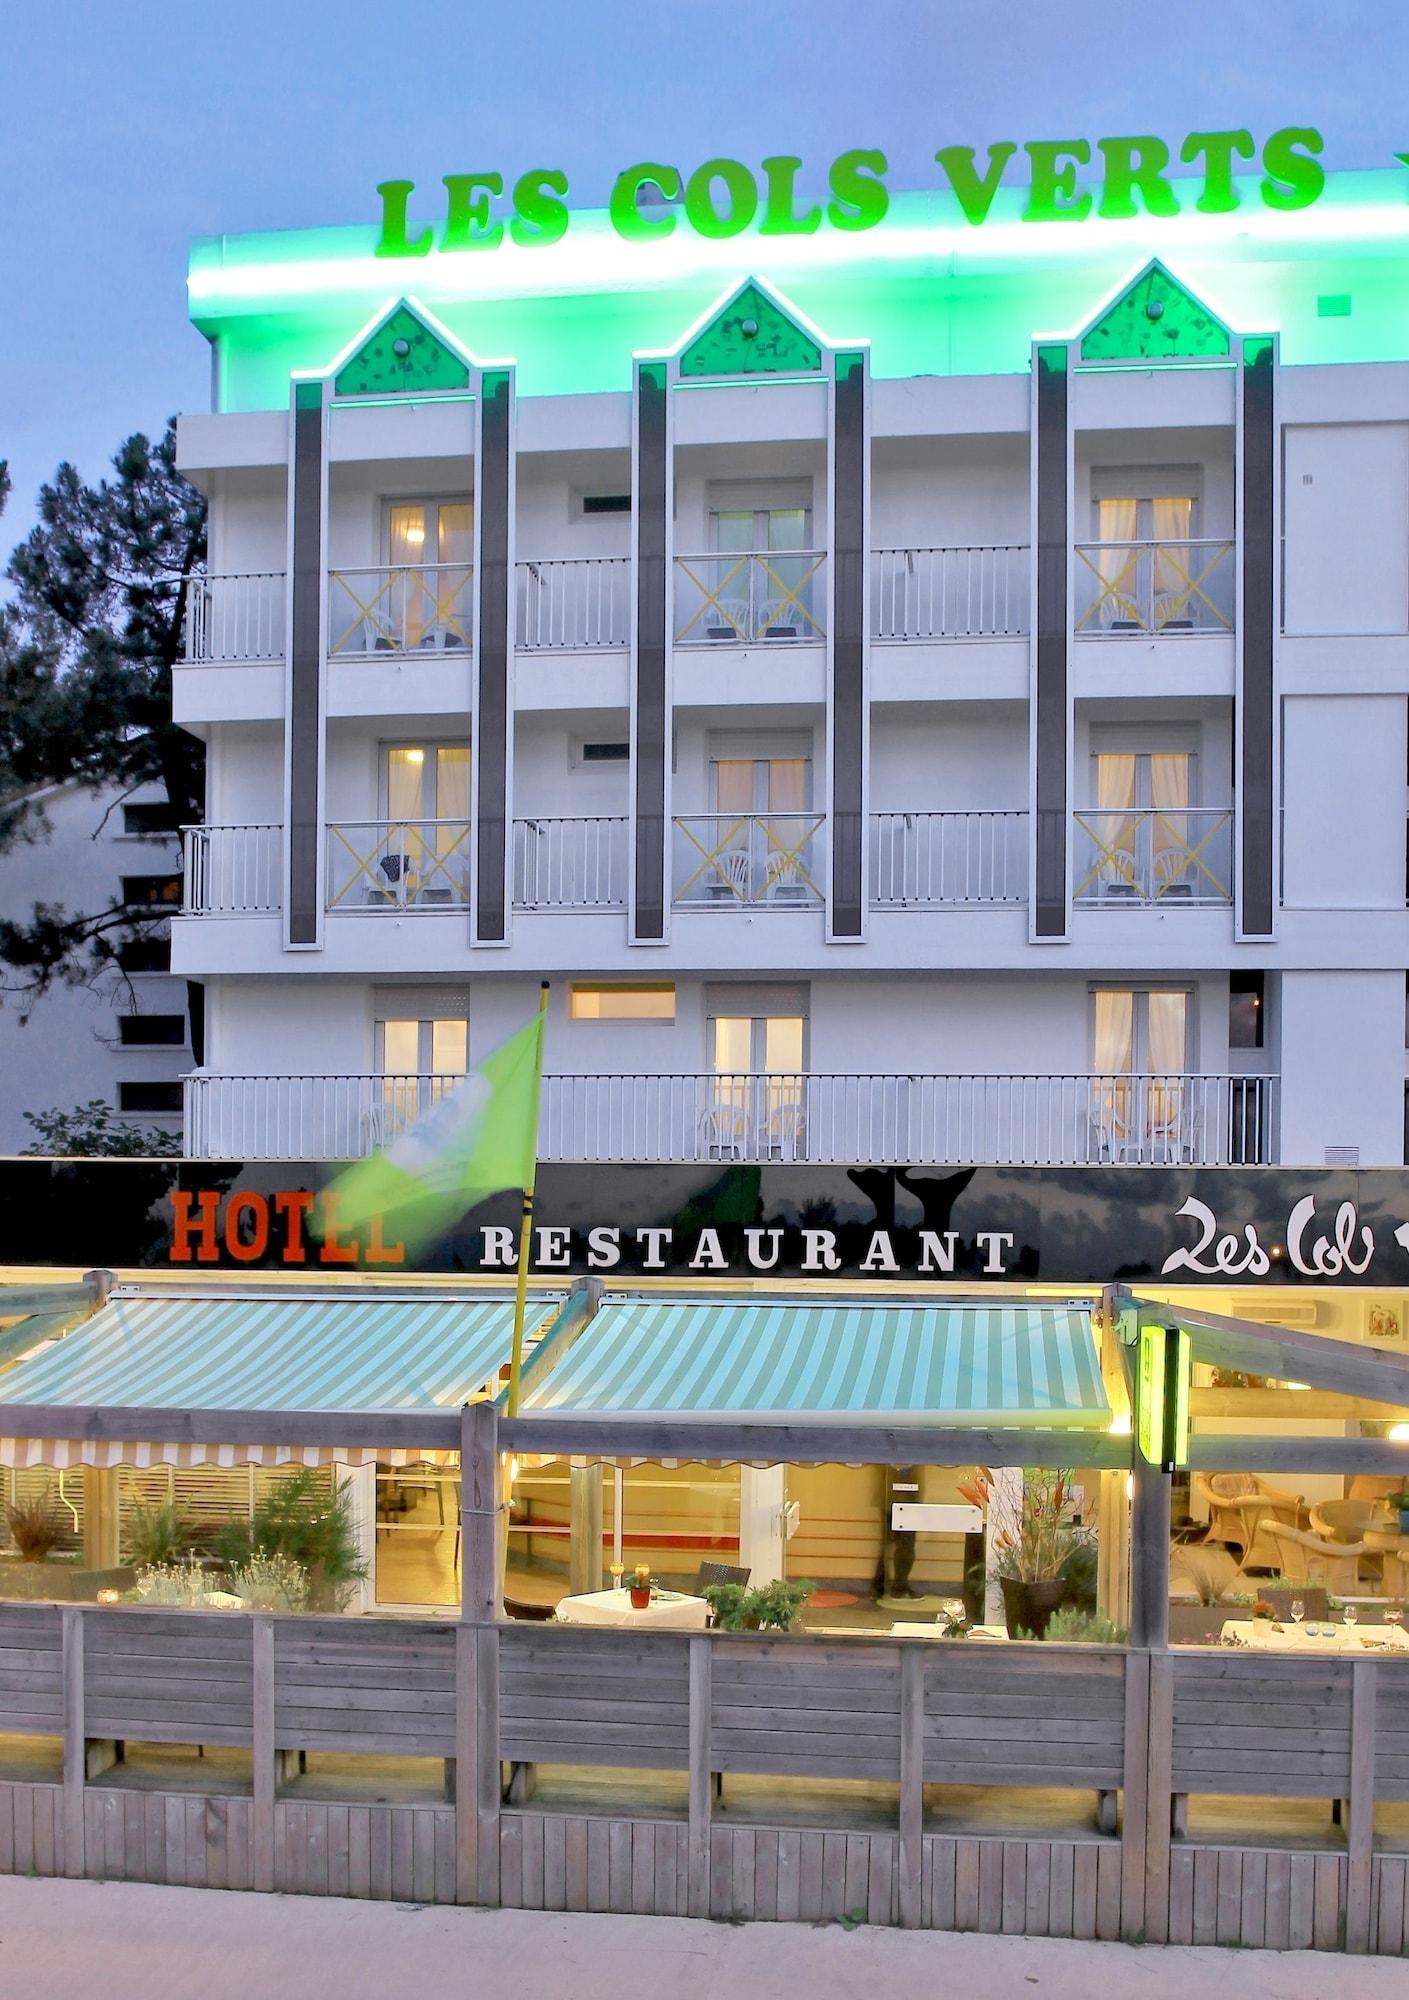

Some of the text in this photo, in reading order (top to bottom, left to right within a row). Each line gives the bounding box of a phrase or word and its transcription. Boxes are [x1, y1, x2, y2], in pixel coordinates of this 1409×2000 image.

[375, 127, 1325, 257] LES COLS VERTS
[169, 1190, 405, 1264] HOTEL
[479, 1225, 1014, 1275] RESTAURANT
[1161, 1195, 1270, 1276] Les
